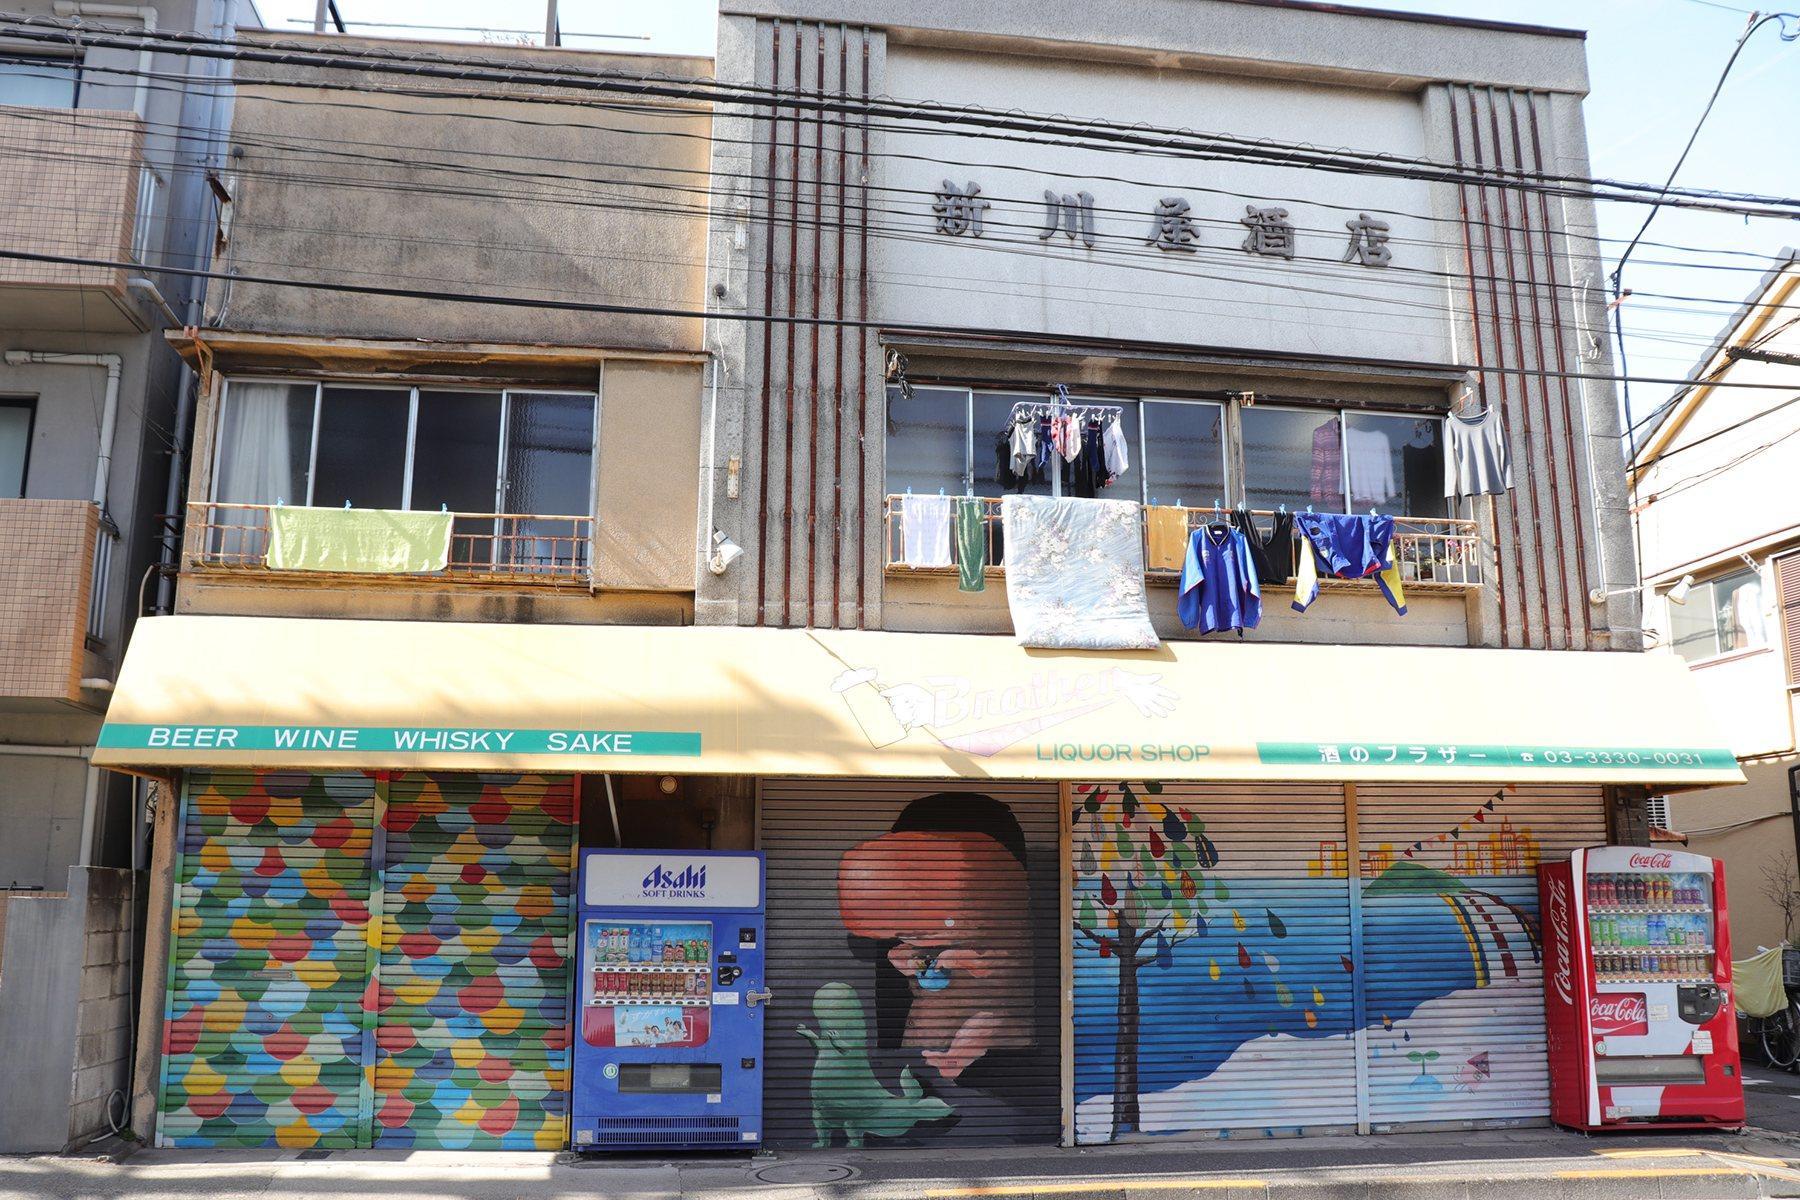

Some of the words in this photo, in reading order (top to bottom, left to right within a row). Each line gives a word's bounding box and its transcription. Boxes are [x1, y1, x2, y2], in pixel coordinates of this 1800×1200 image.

[148, 727, 239, 747] BEER
[274, 729, 359, 748] WINE
[393, 731, 514, 750] WHISKY
[547, 733, 632, 752] SAKE
[1037, 744, 1133, 762] LIQUOR
[1140, 744, 1210, 762] SHOP
[1544, 751, 1704, 765] 03-3330-0031
[1629, 853, 1673, 869] Coca-Cola
[642, 864, 706, 889] Asahi
[643, 889, 667, 898] SOFT
[669, 889, 706, 898] DRINKS
[1548, 872, 1573, 1005] Coca-Cola
